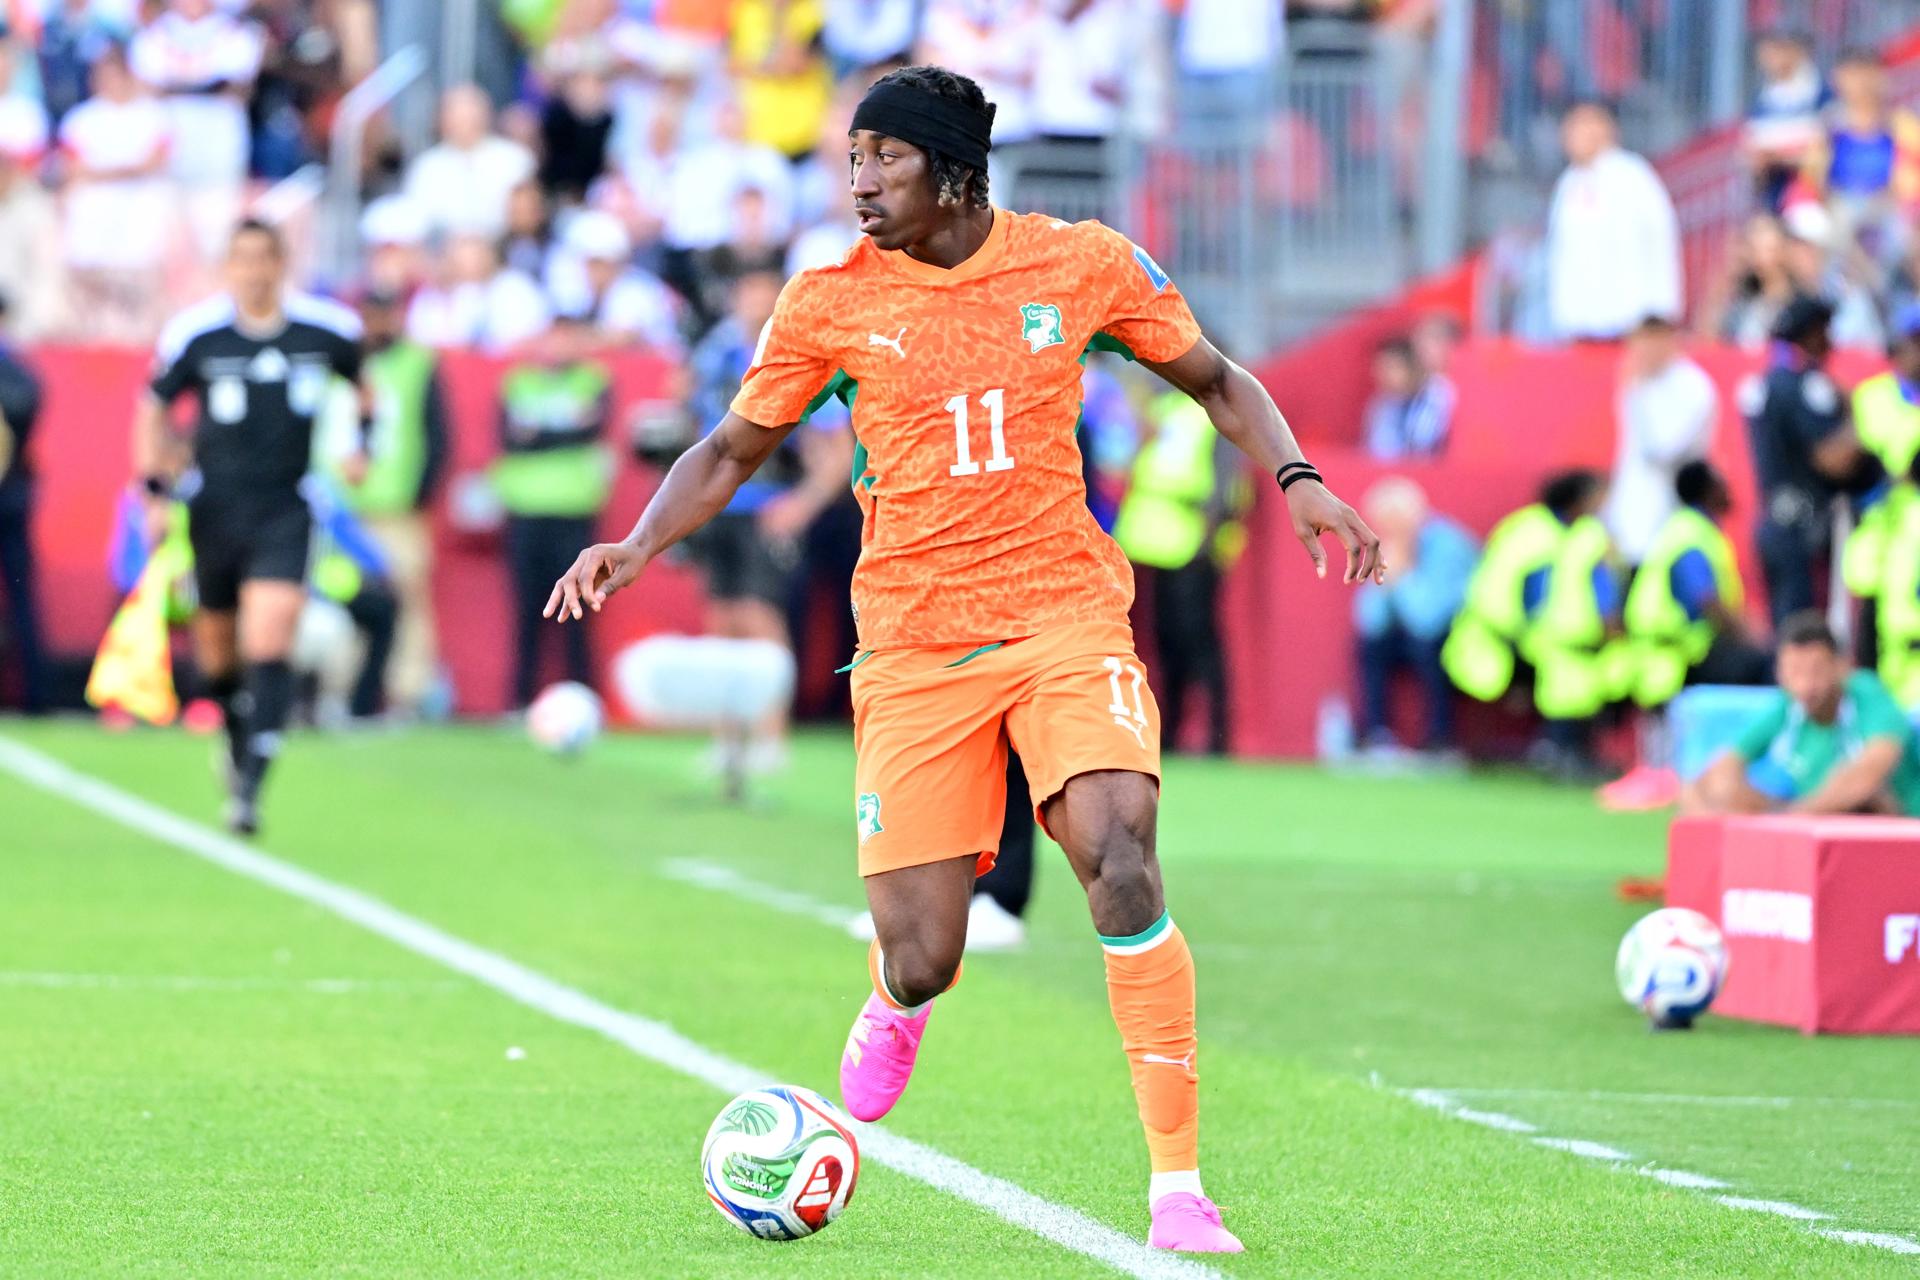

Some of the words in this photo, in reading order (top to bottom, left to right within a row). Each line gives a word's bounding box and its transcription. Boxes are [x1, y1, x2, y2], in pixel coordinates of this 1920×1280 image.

[944, 388, 1015, 477] 11
[1103, 656, 1148, 727] 11
[1884, 914, 1920, 964] F
